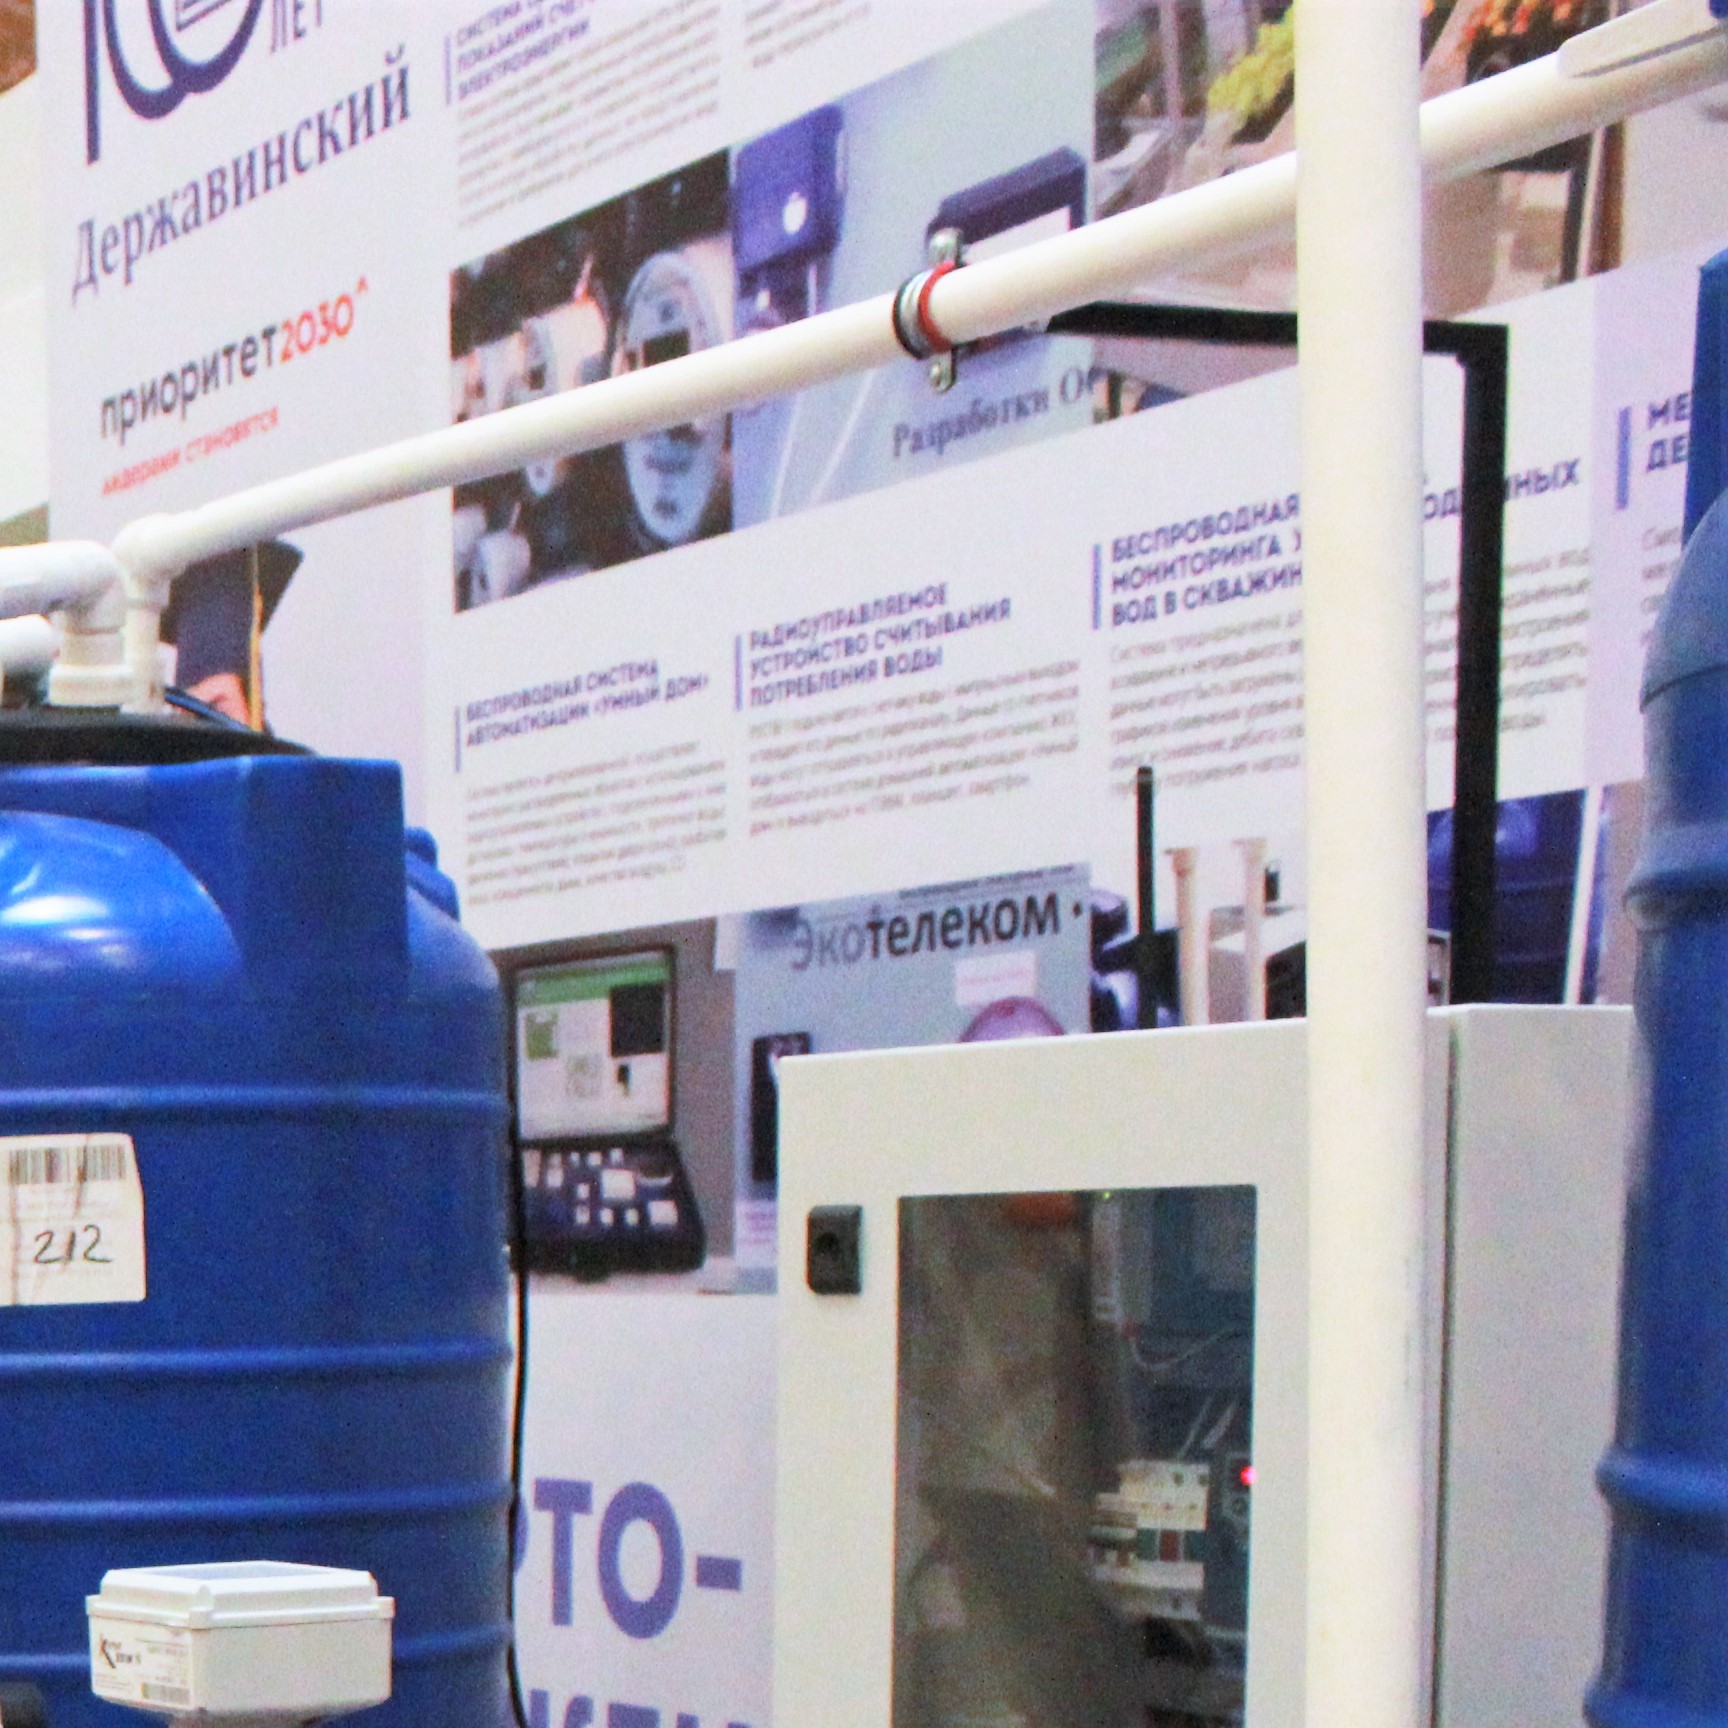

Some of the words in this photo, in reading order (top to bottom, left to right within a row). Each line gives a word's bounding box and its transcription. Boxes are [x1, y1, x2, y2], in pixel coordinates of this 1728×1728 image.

[71, 43, 411, 306] Державинский
[1111, 492, 1301, 563] БЕСПРОВОДНАЯ
[1111, 533, 1282, 594] МОНИТОРИНГА
[1111, 593, 1158, 627] ВОД
[1165, 590, 1178, 616] В
[1184, 559, 1303, 611] СКВАЖИН
[750, 581, 948, 650] РАДИОУПРАВЛЯЕМОЕ
[750, 632, 870, 681] УСТРОЙСТВО
[875, 597, 1012, 653] СЧИТЫВАНИЯ
[586, 657, 658, 691] СИСТЕМА
[750, 658, 878, 708] ПОТРЕБЛЕНИЯ
[884, 646, 944, 678] ВОДЫ
[512, 1478, 743, 1640] ТО-
